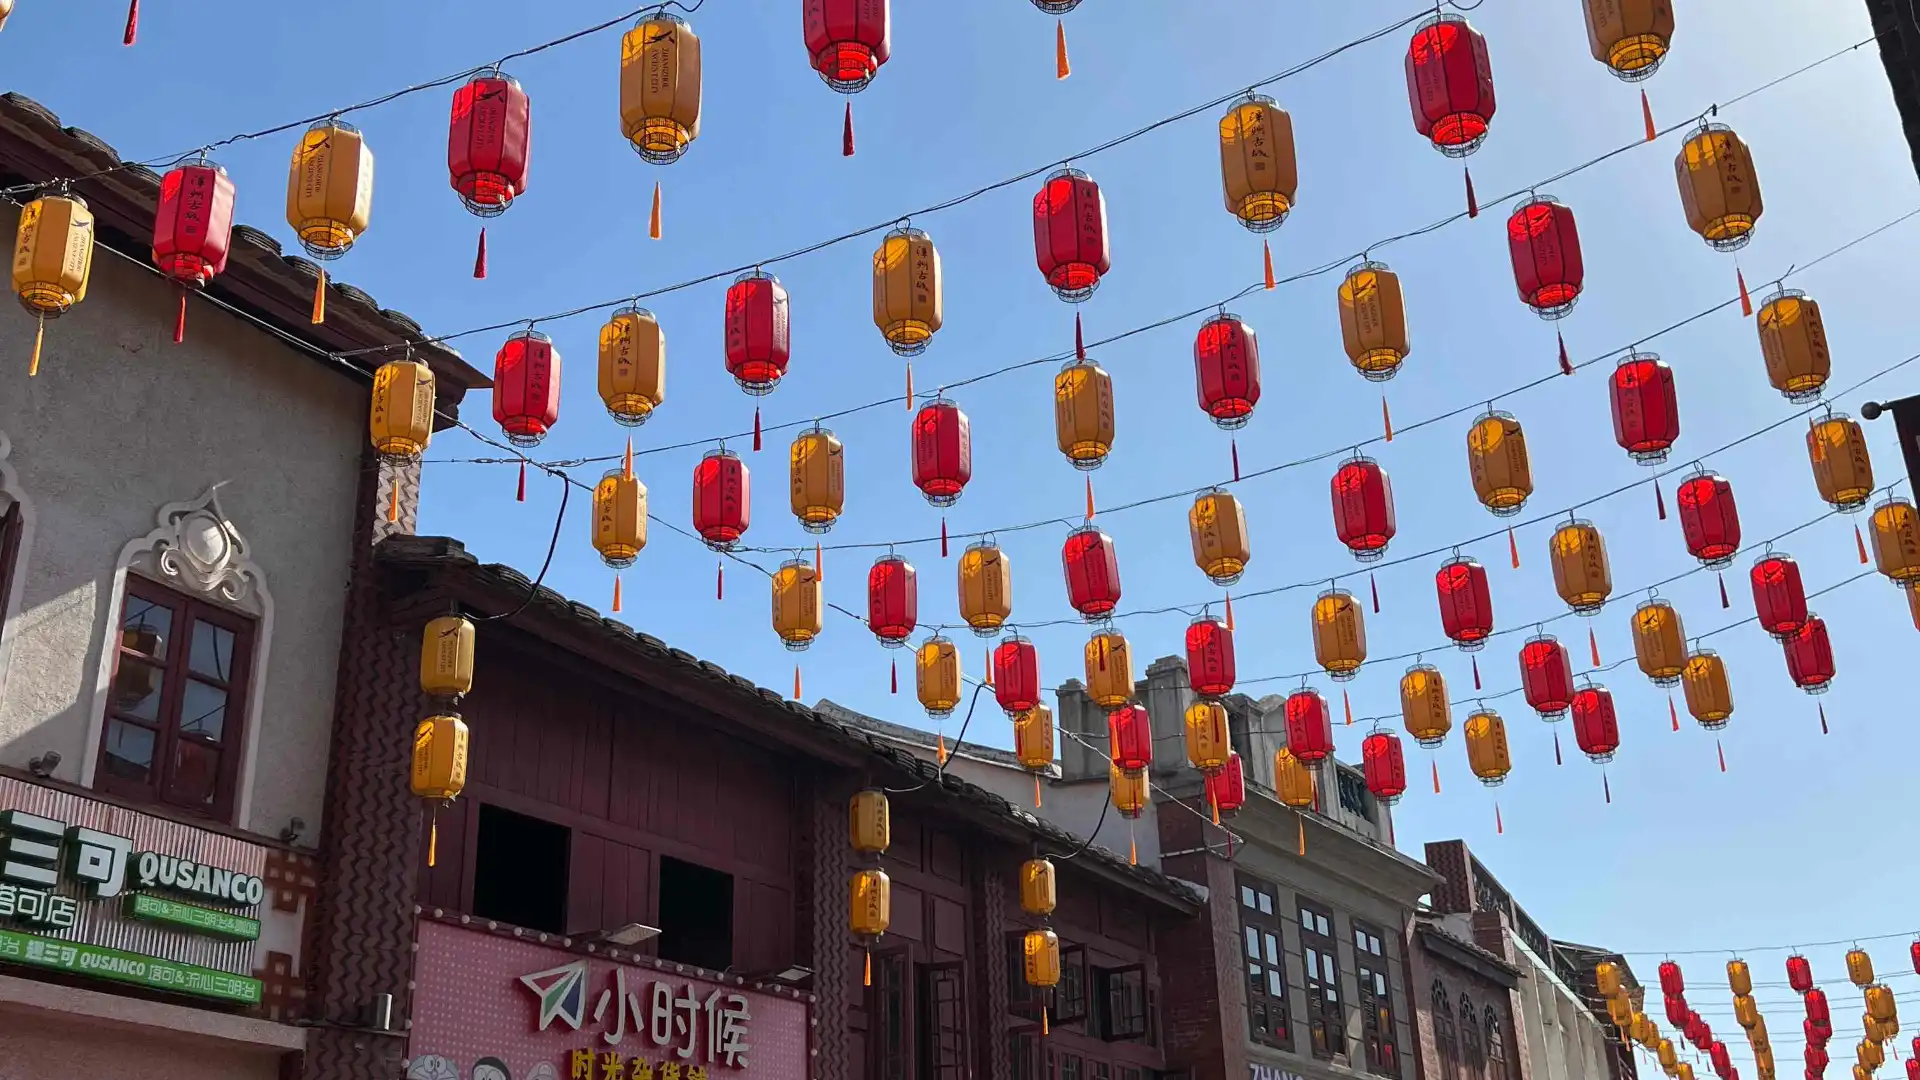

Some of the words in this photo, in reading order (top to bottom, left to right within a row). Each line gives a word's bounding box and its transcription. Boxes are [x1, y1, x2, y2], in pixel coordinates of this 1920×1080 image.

[1250, 111, 1269, 158] 漳州古城
[185, 174, 207, 224] 漳州古城
[914, 244, 931, 293] 漳州古城
[616, 321, 633, 366] 漳州古城
[4, 811, 133, 897] 三可
[138, 851, 264, 905] QUSANCO
[80, 952, 146, 977] QUSANCO
[593, 966, 753, 1069] 小时候
